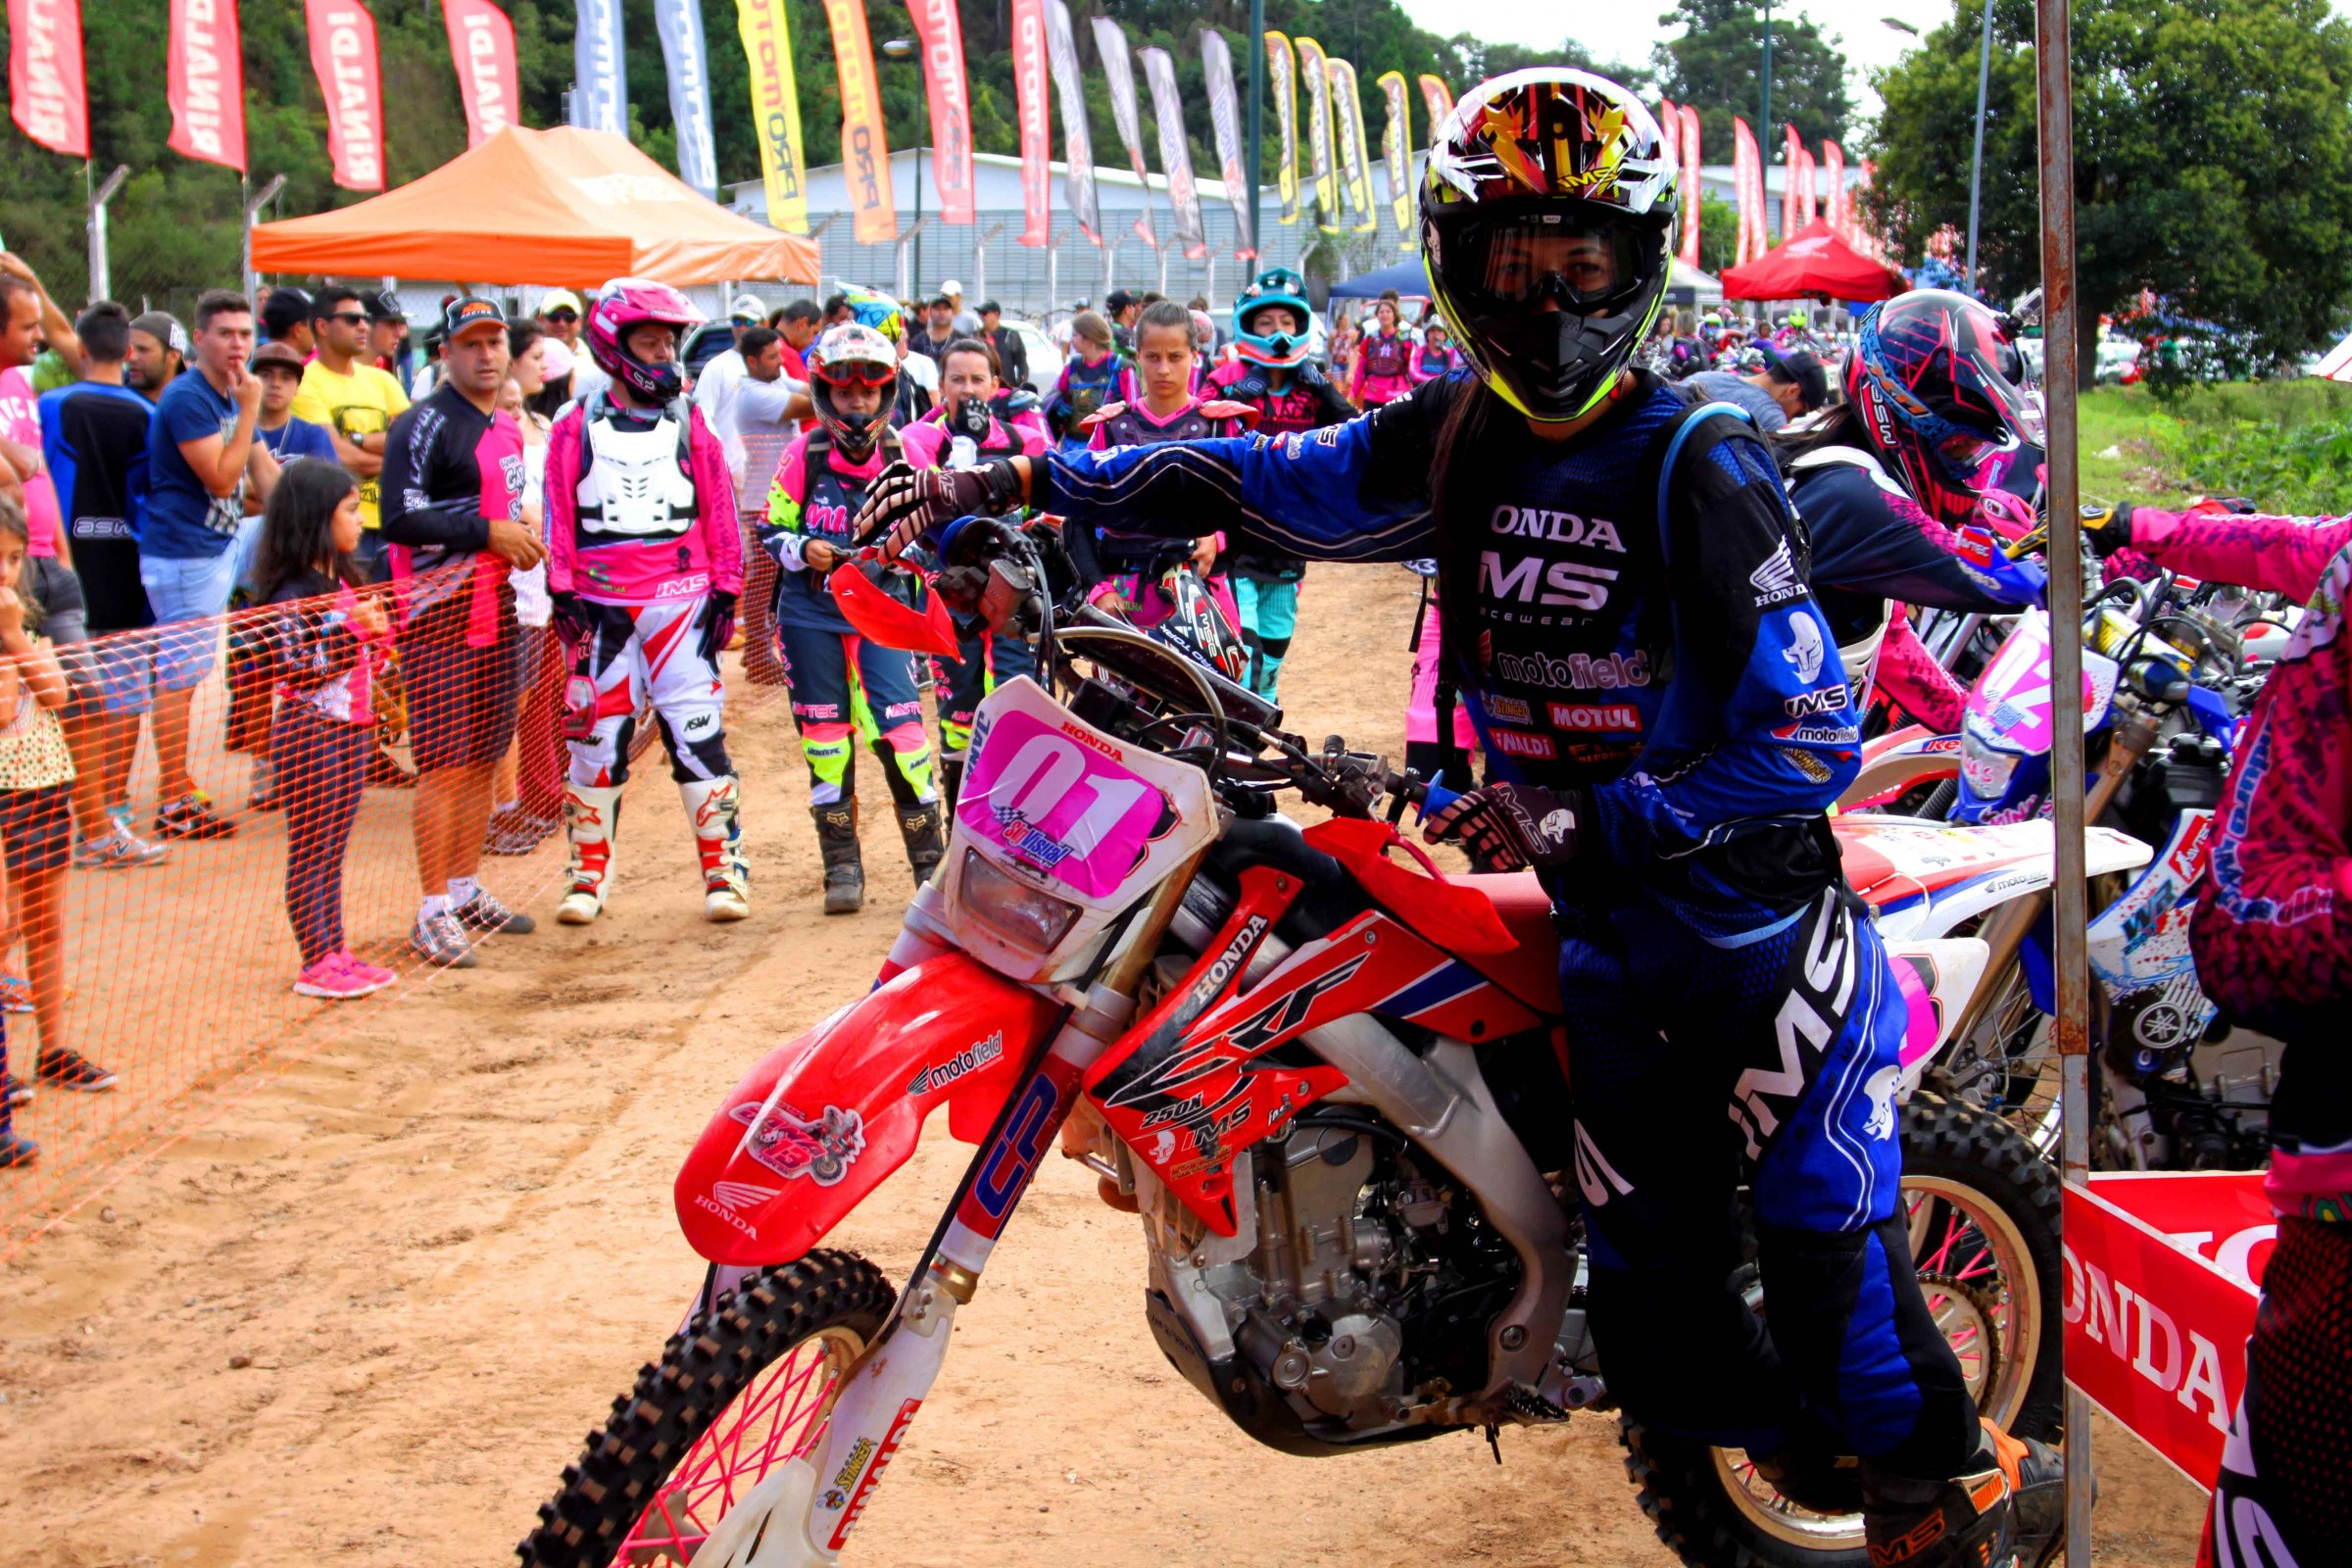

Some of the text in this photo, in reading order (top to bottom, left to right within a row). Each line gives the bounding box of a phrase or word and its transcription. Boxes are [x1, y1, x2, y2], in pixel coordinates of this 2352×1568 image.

[1558, 166, 1616, 191] IMS
[1491, 505, 1628, 554] ONDA
[655, 573, 711, 601] IMS
[1477, 550, 1620, 612] MS
[1754, 583, 1810, 609] HOND
[1159, 623, 1192, 654] TORK
[1479, 607, 1594, 626] acewear
[1497, 650, 1652, 690] motofield
[684, 713, 711, 731] ASW
[1552, 707, 1638, 729] MOTUL
[1785, 683, 1847, 718] IMS
[1060, 720, 1125, 763] HONDA
[1927, 738, 1962, 753] Ke
[2228, 698, 2277, 838] nduro
[989, 734, 1149, 862] 01
[1192, 913, 1269, 1005] HONDA
[1103, 950, 1372, 1109] CRF
[1727, 885, 1857, 1162] IMS
[929, 1029, 1004, 1090] motofield
[1180, 1097, 1252, 1152] IMS
[693, 1194, 760, 1242] HONDA
[2062, 1241, 2230, 1435] ONDA
[835, 1437, 879, 1495] STINGER
